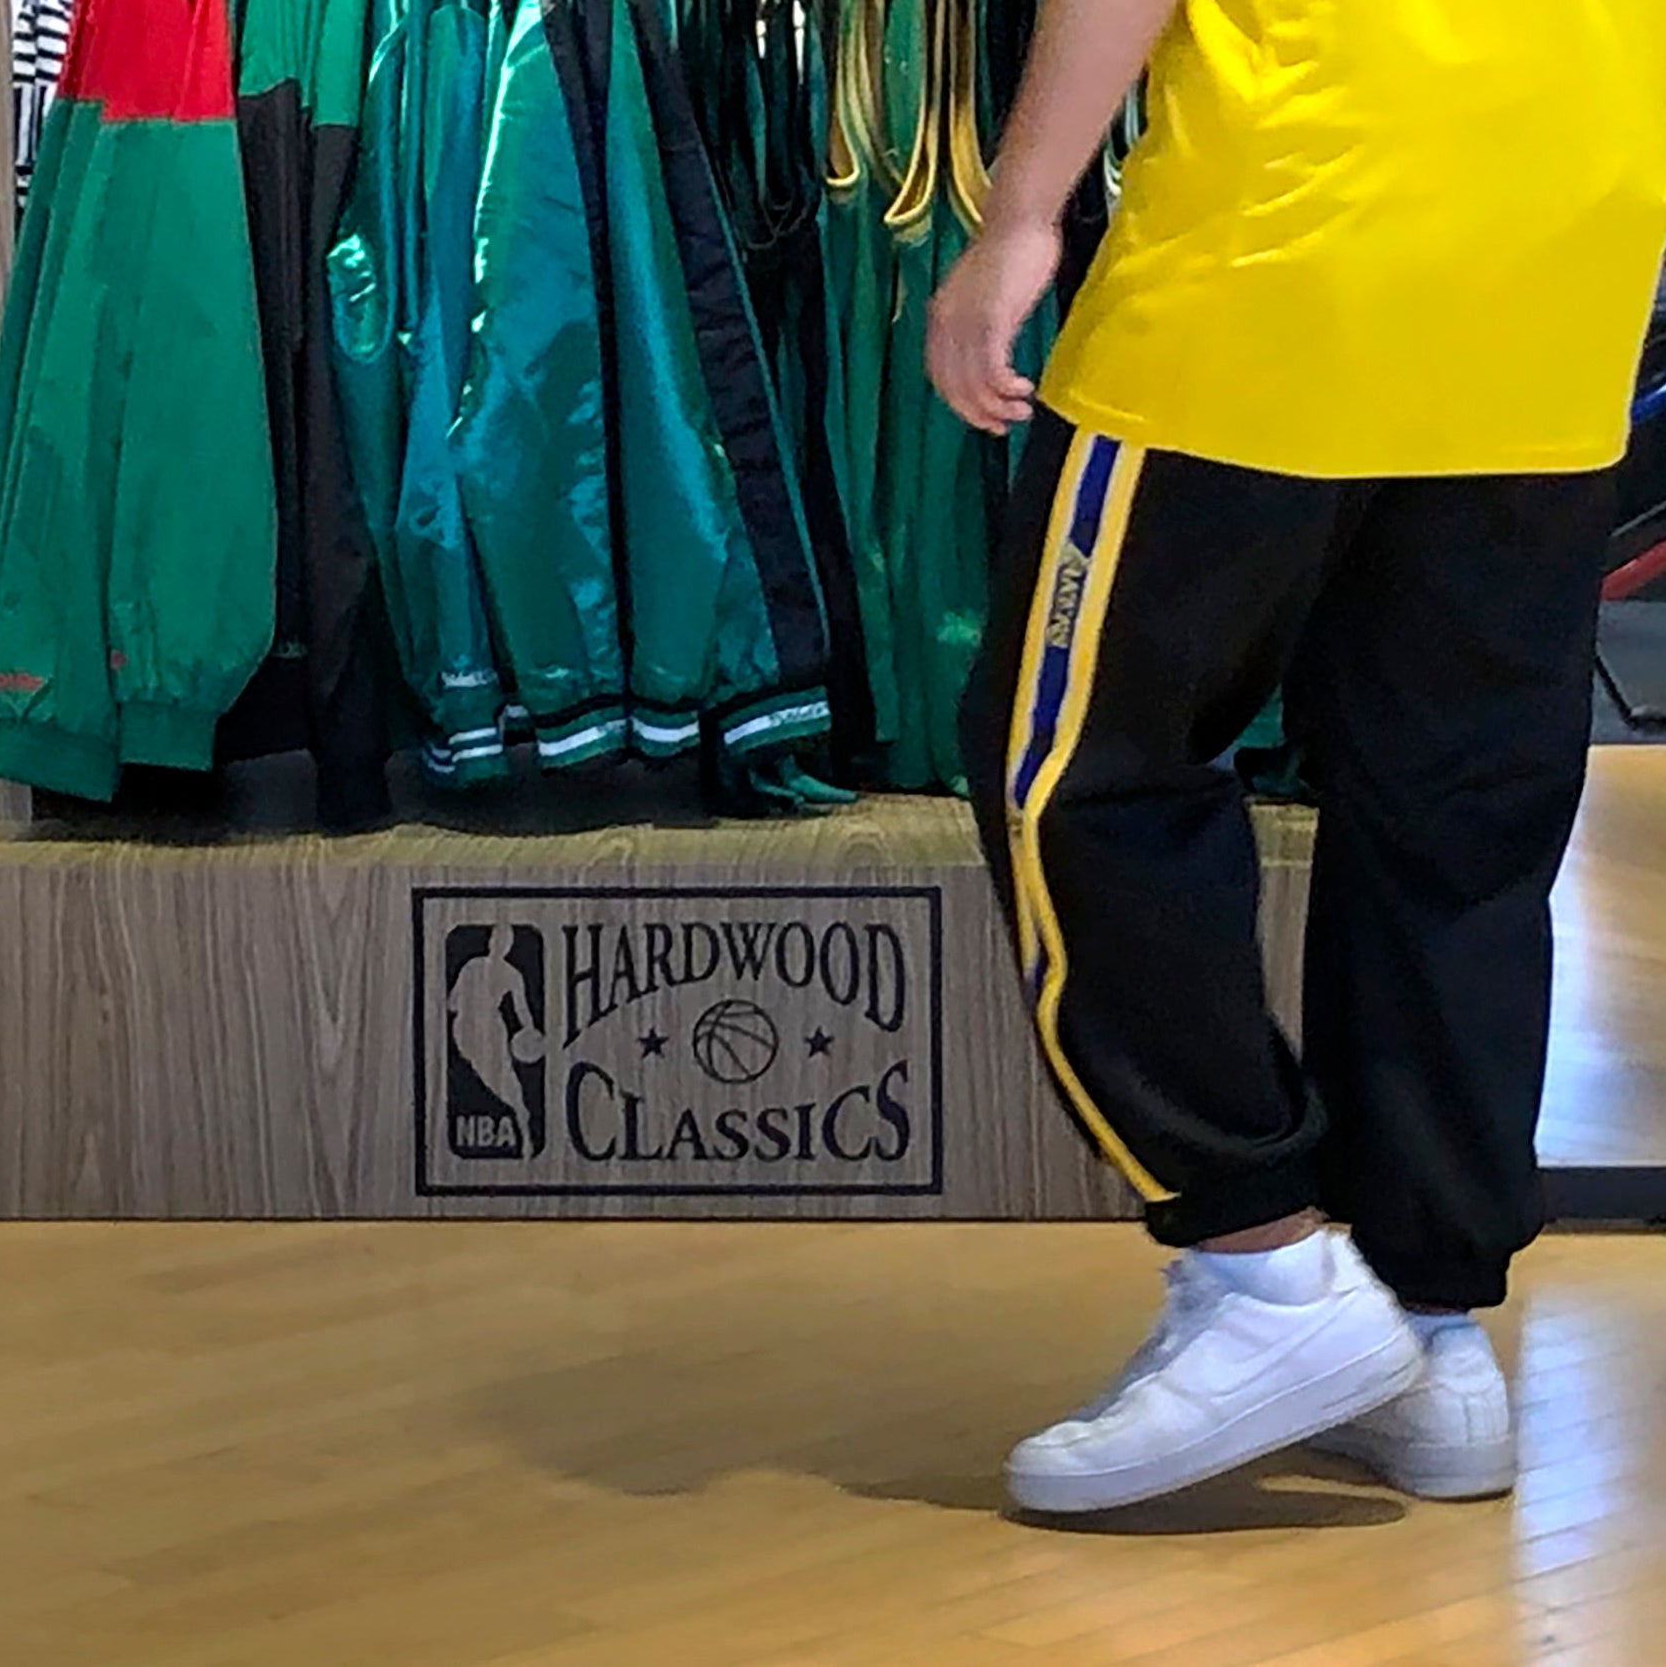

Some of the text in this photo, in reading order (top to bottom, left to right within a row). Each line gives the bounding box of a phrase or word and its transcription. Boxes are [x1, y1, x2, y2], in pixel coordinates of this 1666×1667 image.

[561, 921, 906, 1050] HARDWOOD
[455, 1115, 517, 1149] NBA
[565, 1058, 910, 1163] CLASSICS
